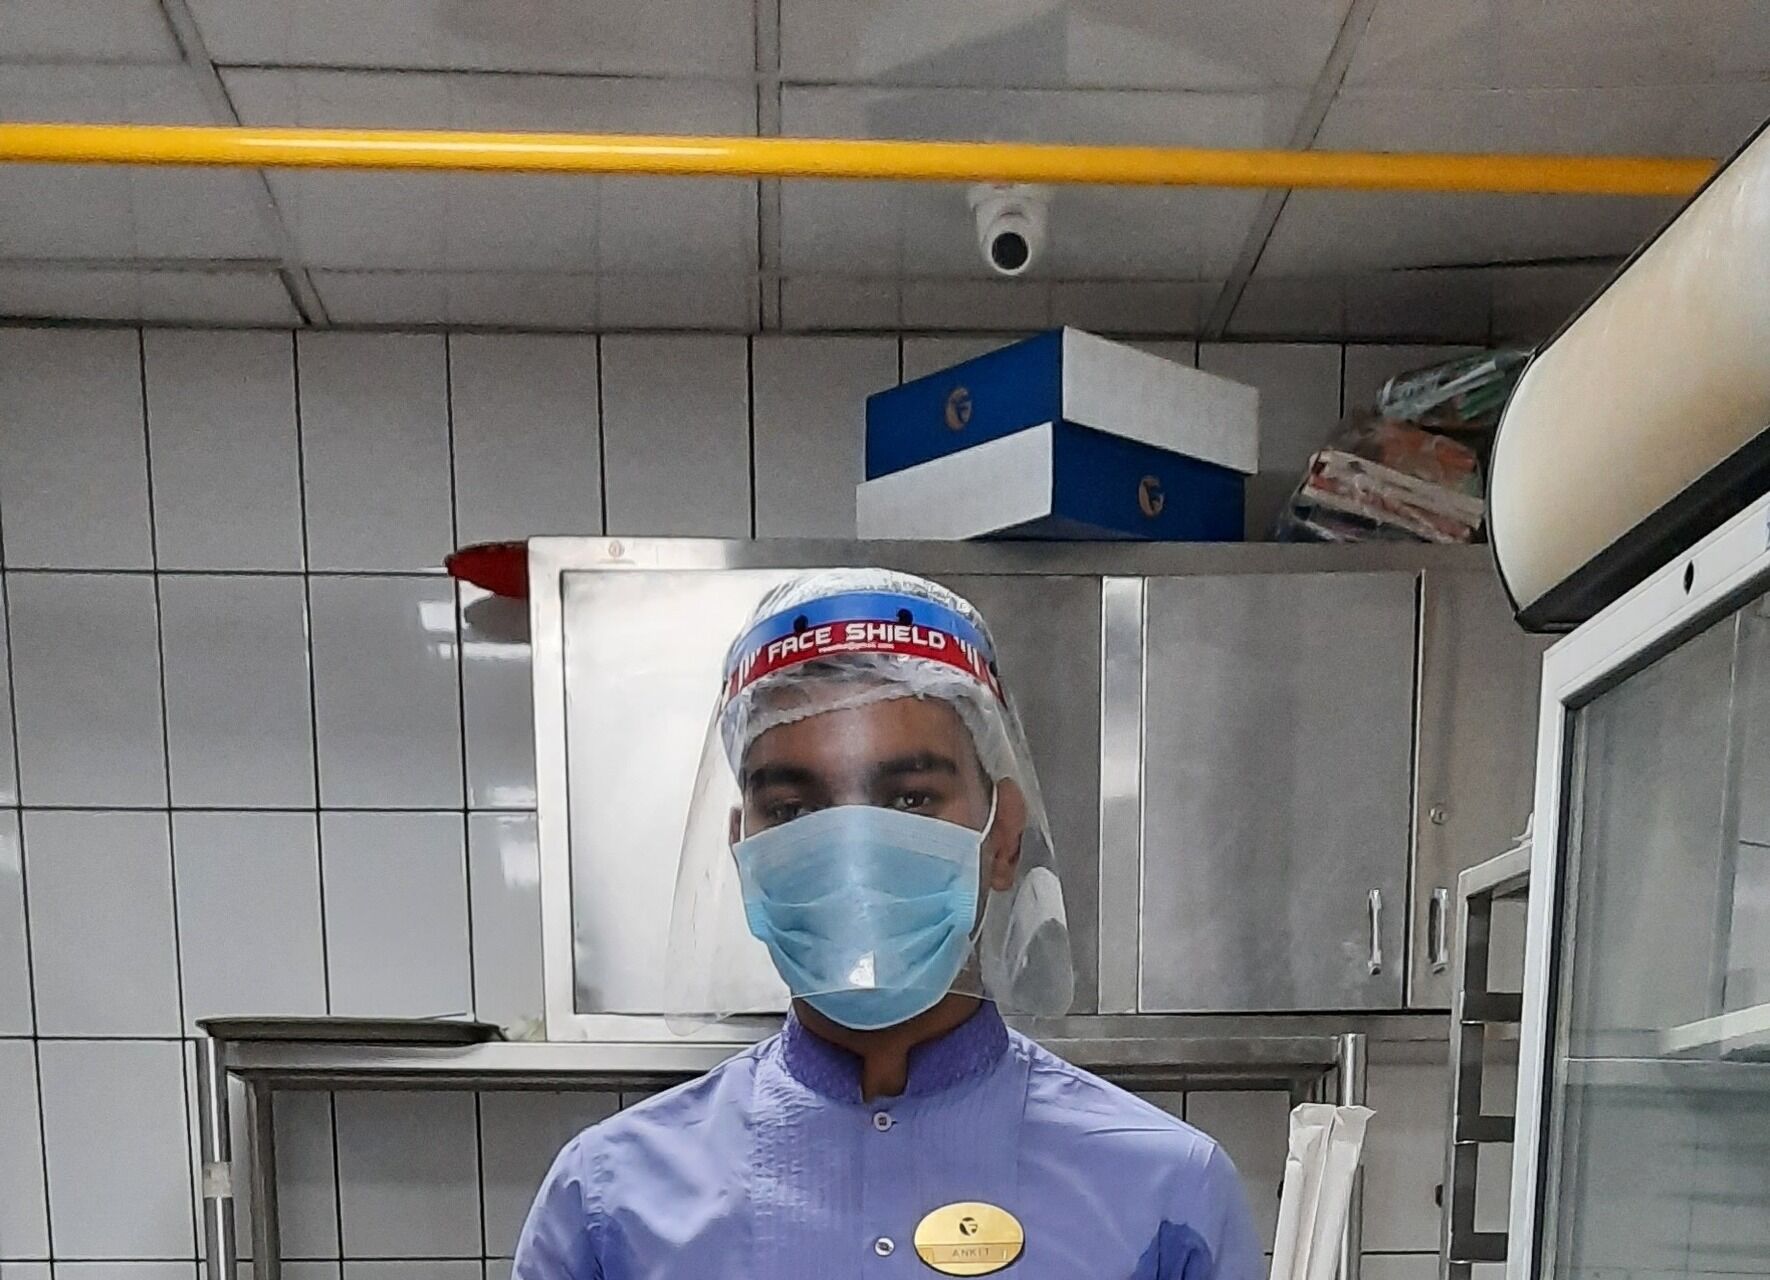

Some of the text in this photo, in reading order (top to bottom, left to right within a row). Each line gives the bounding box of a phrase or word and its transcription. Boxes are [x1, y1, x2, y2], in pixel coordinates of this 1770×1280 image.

[767, 623, 947, 664] FACE SHIELD
[952, 1247, 989, 1257] ANKIT
